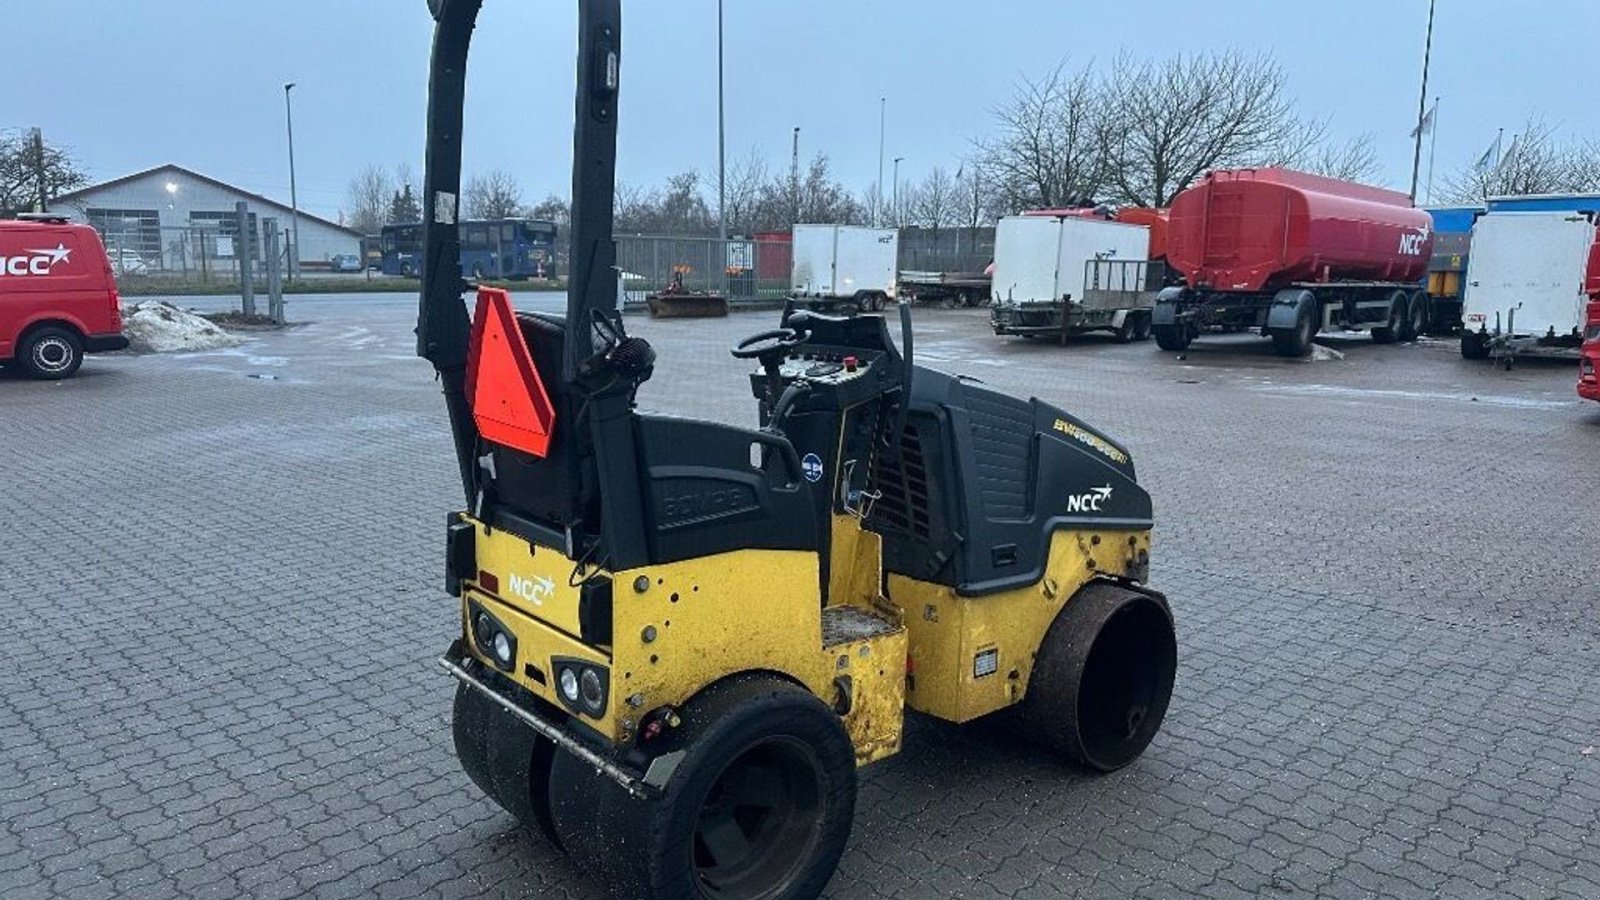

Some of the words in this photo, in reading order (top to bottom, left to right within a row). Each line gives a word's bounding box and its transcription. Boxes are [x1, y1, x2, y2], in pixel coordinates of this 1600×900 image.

[1398, 233, 1422, 255] NCC
[0, 256, 50, 275] CC
[1067, 493, 1102, 512] NCC
[508, 572, 543, 606] NCC
